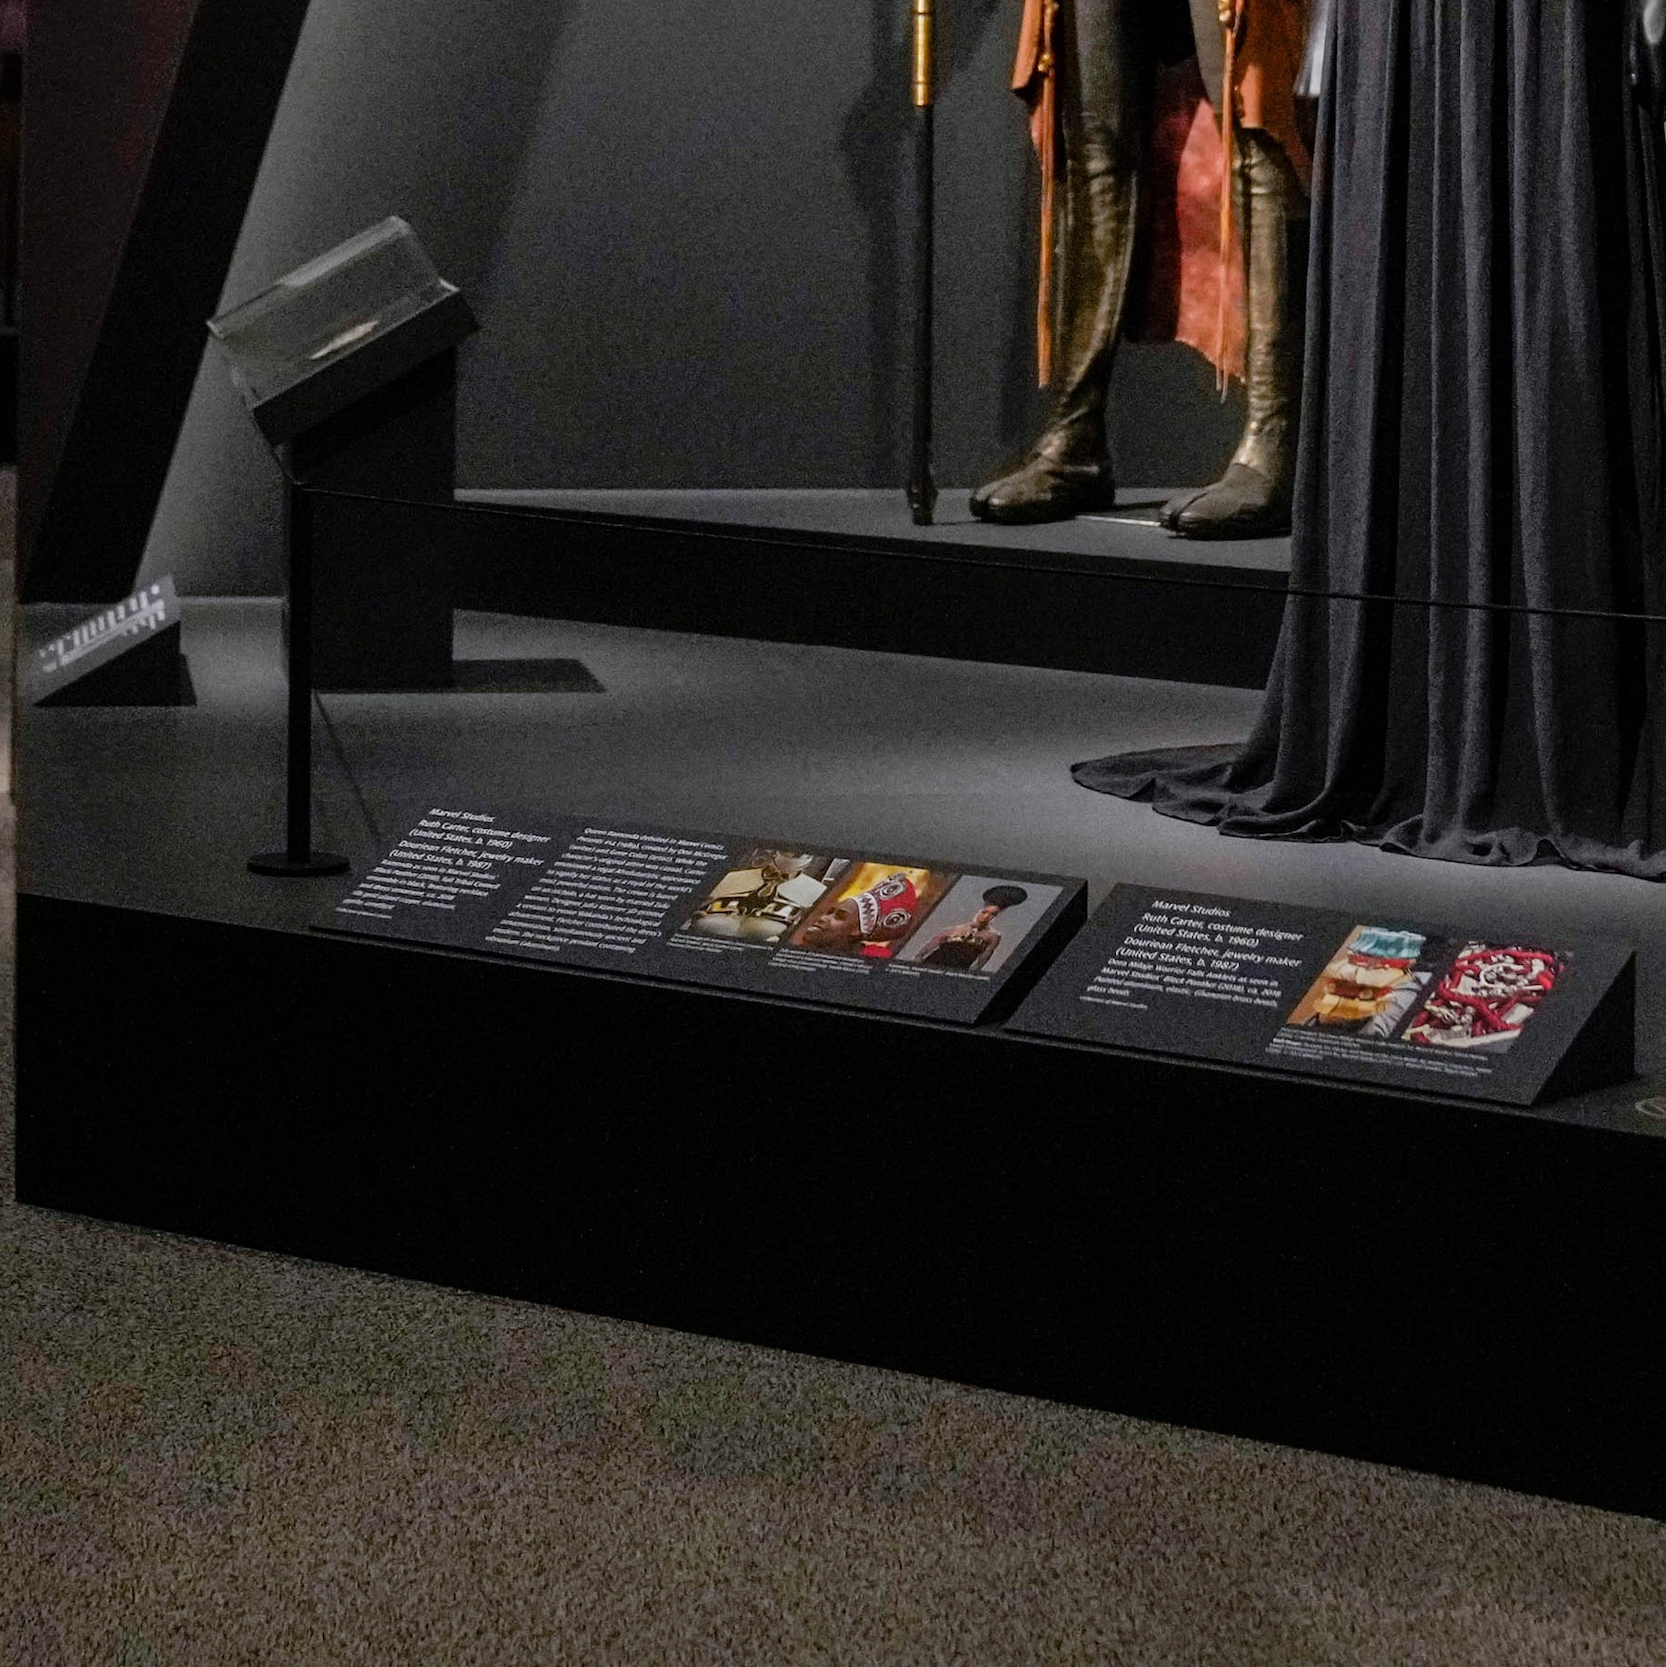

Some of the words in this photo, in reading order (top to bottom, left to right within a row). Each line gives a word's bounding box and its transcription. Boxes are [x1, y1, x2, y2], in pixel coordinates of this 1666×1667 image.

[429, 808, 462, 818] Marvel
[461, 812, 495, 822] Studios
[409, 829, 445, 839] (United
[444, 833, 472, 843] States,
[486, 839, 513, 849] 1960)
[418, 819, 441, 828] Ruth
[441, 822, 470, 833] Carter,
[472, 828, 510, 837] costume
[511, 832, 551, 842] designer
[389, 849, 425, 860] (United
[424, 854, 453, 865] States,
[467, 860, 492, 870] 1987)
[398, 840, 440, 851] Douriean
[440, 846, 478, 857] Fletcher,
[477, 851, 514, 863] jewelry
[514, 857, 544, 865] maker
[1152, 900, 1190, 912] Marvel
[1191, 905, 1230, 917] Studios
[1134, 924, 1176, 936] (United
[1176, 929, 1210, 941] States,
[1214, 933, 1223, 943] b.
[1229, 936, 1259, 948] 1960)
[1142, 913, 1168, 923] Ruth
[1170, 917, 1204, 929] Carter,
[1208, 923, 1253, 934] costume
[1256, 928, 1303, 940] designer
[1116, 947, 1158, 959] (United
[1158, 953, 1192, 965] States,
[1196, 958, 1205, 967] b.
[1211, 960, 1239, 971] 1987)
[1124, 937, 1173, 949] Douriean
[1175, 943, 1219, 957] Fletcher,
[1221, 950, 1264, 963] jewelry
[1265, 956, 1301, 967] maker
[1101, 967, 1130, 976] Marvel
[1108, 958, 1127, 967] Dora
[1155, 965, 1185, 974] Warrior
